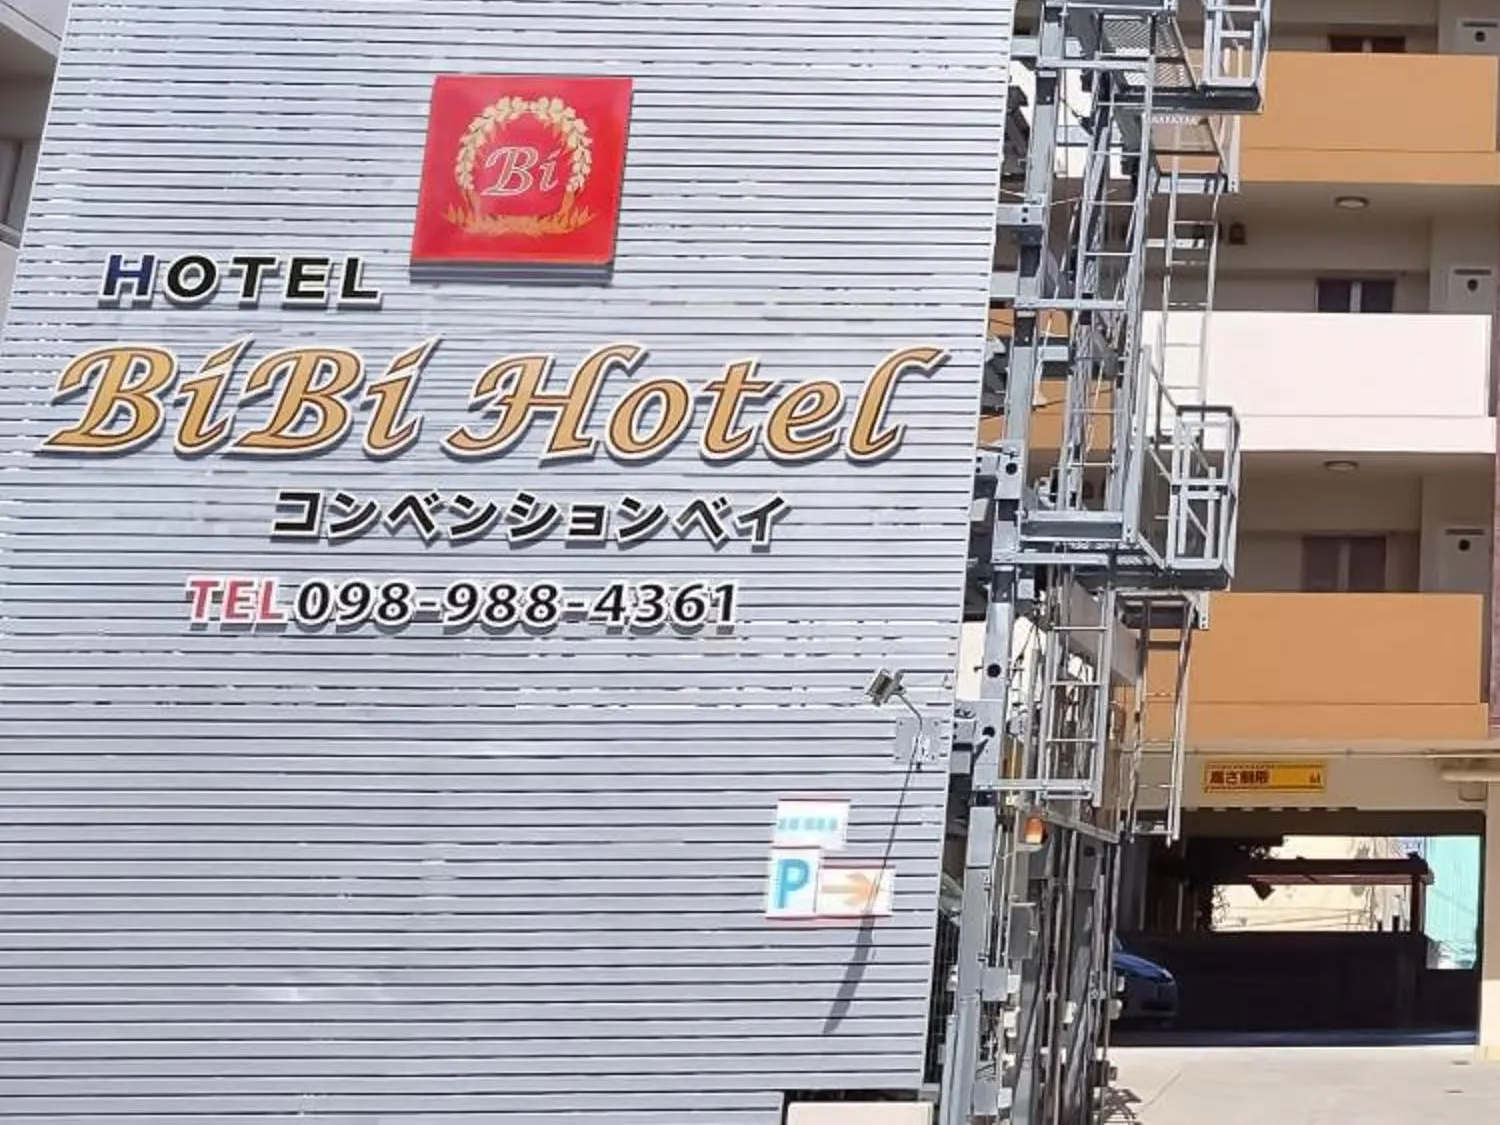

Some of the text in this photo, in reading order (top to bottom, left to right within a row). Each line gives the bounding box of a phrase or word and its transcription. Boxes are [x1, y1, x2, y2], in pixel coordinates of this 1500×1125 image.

[478, 143, 564, 198] Bi
[99, 252, 383, 305] HOTEL
[38, 333, 952, 463] BiBi Hotel
[271, 489, 793, 545] コンベンションベイ
[775, 858, 810, 909] P
